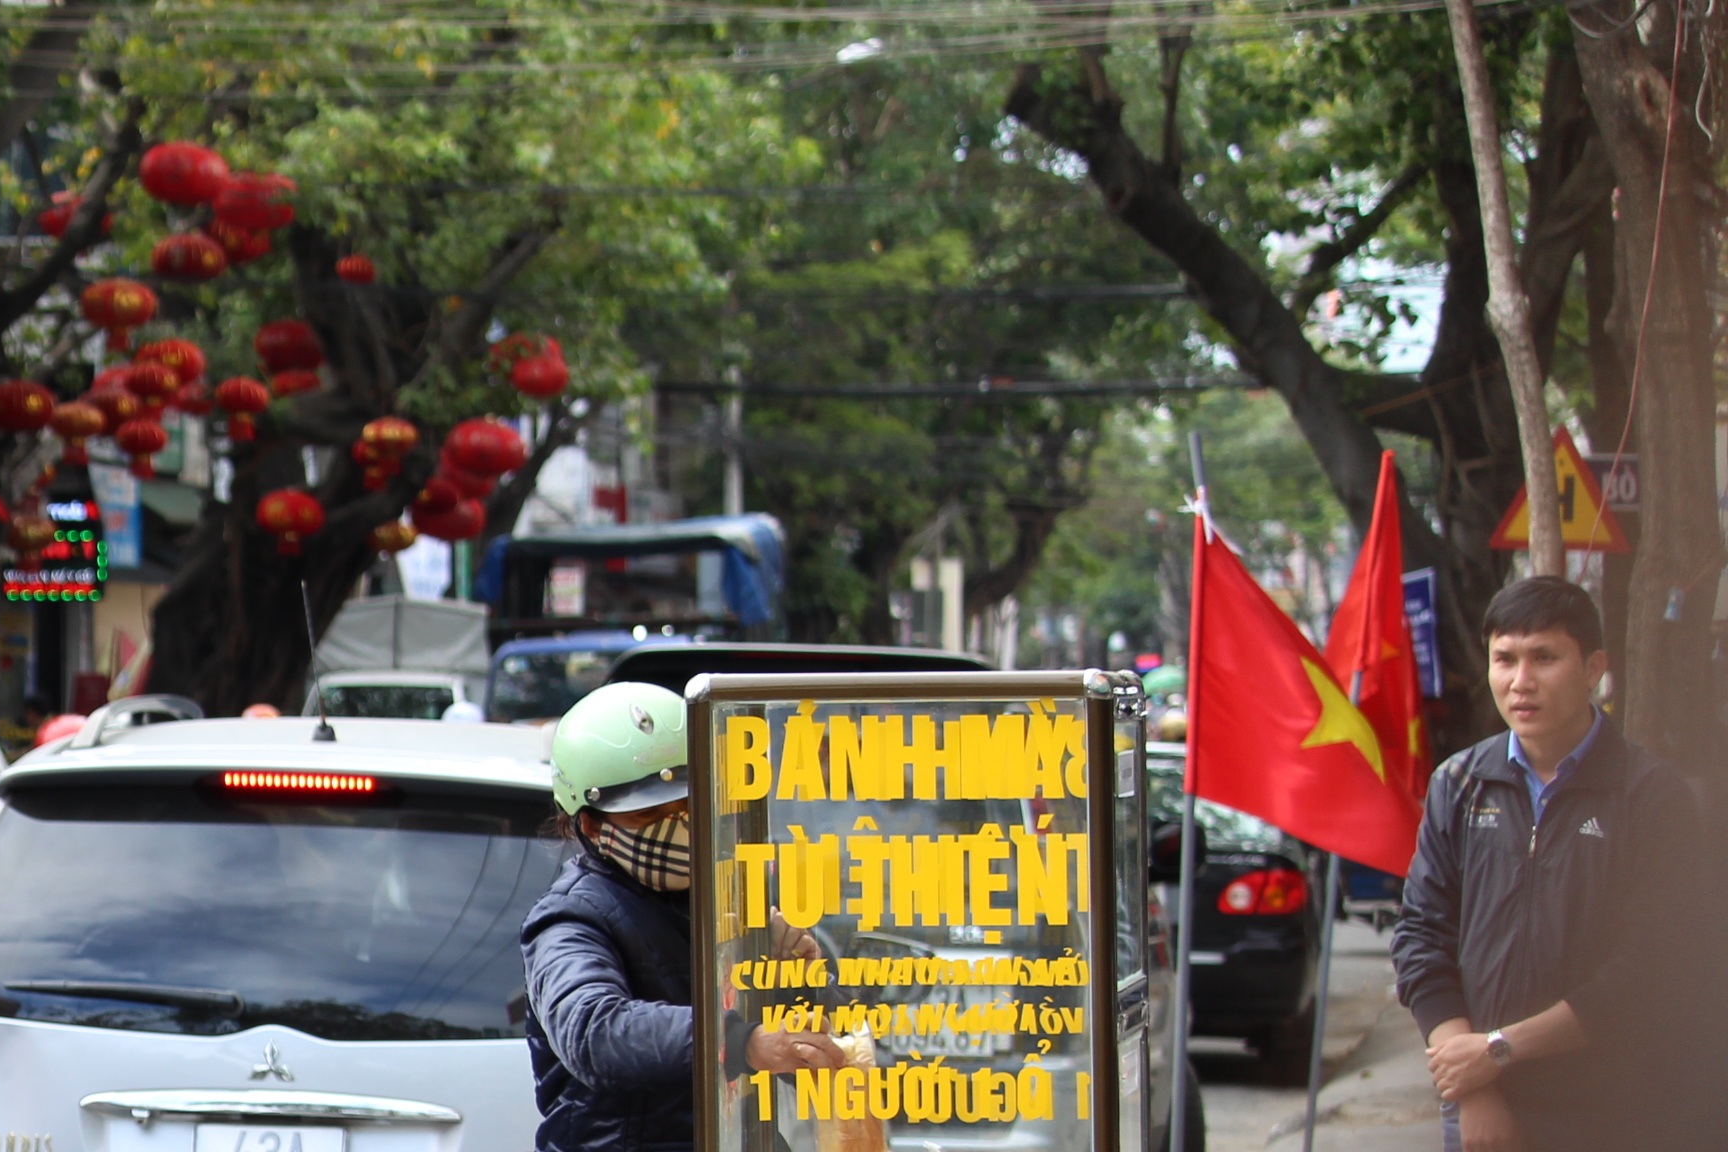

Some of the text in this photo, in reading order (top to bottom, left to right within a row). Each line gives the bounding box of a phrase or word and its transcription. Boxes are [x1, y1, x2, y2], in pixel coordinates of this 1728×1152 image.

[726, 699, 932, 801] BÁNH
[730, 955, 827, 990] CÙNG
[762, 996, 823, 1033] VỚI
[750, 1070, 771, 1121] 1
[796, 1051, 951, 1121] NGƯỜI
